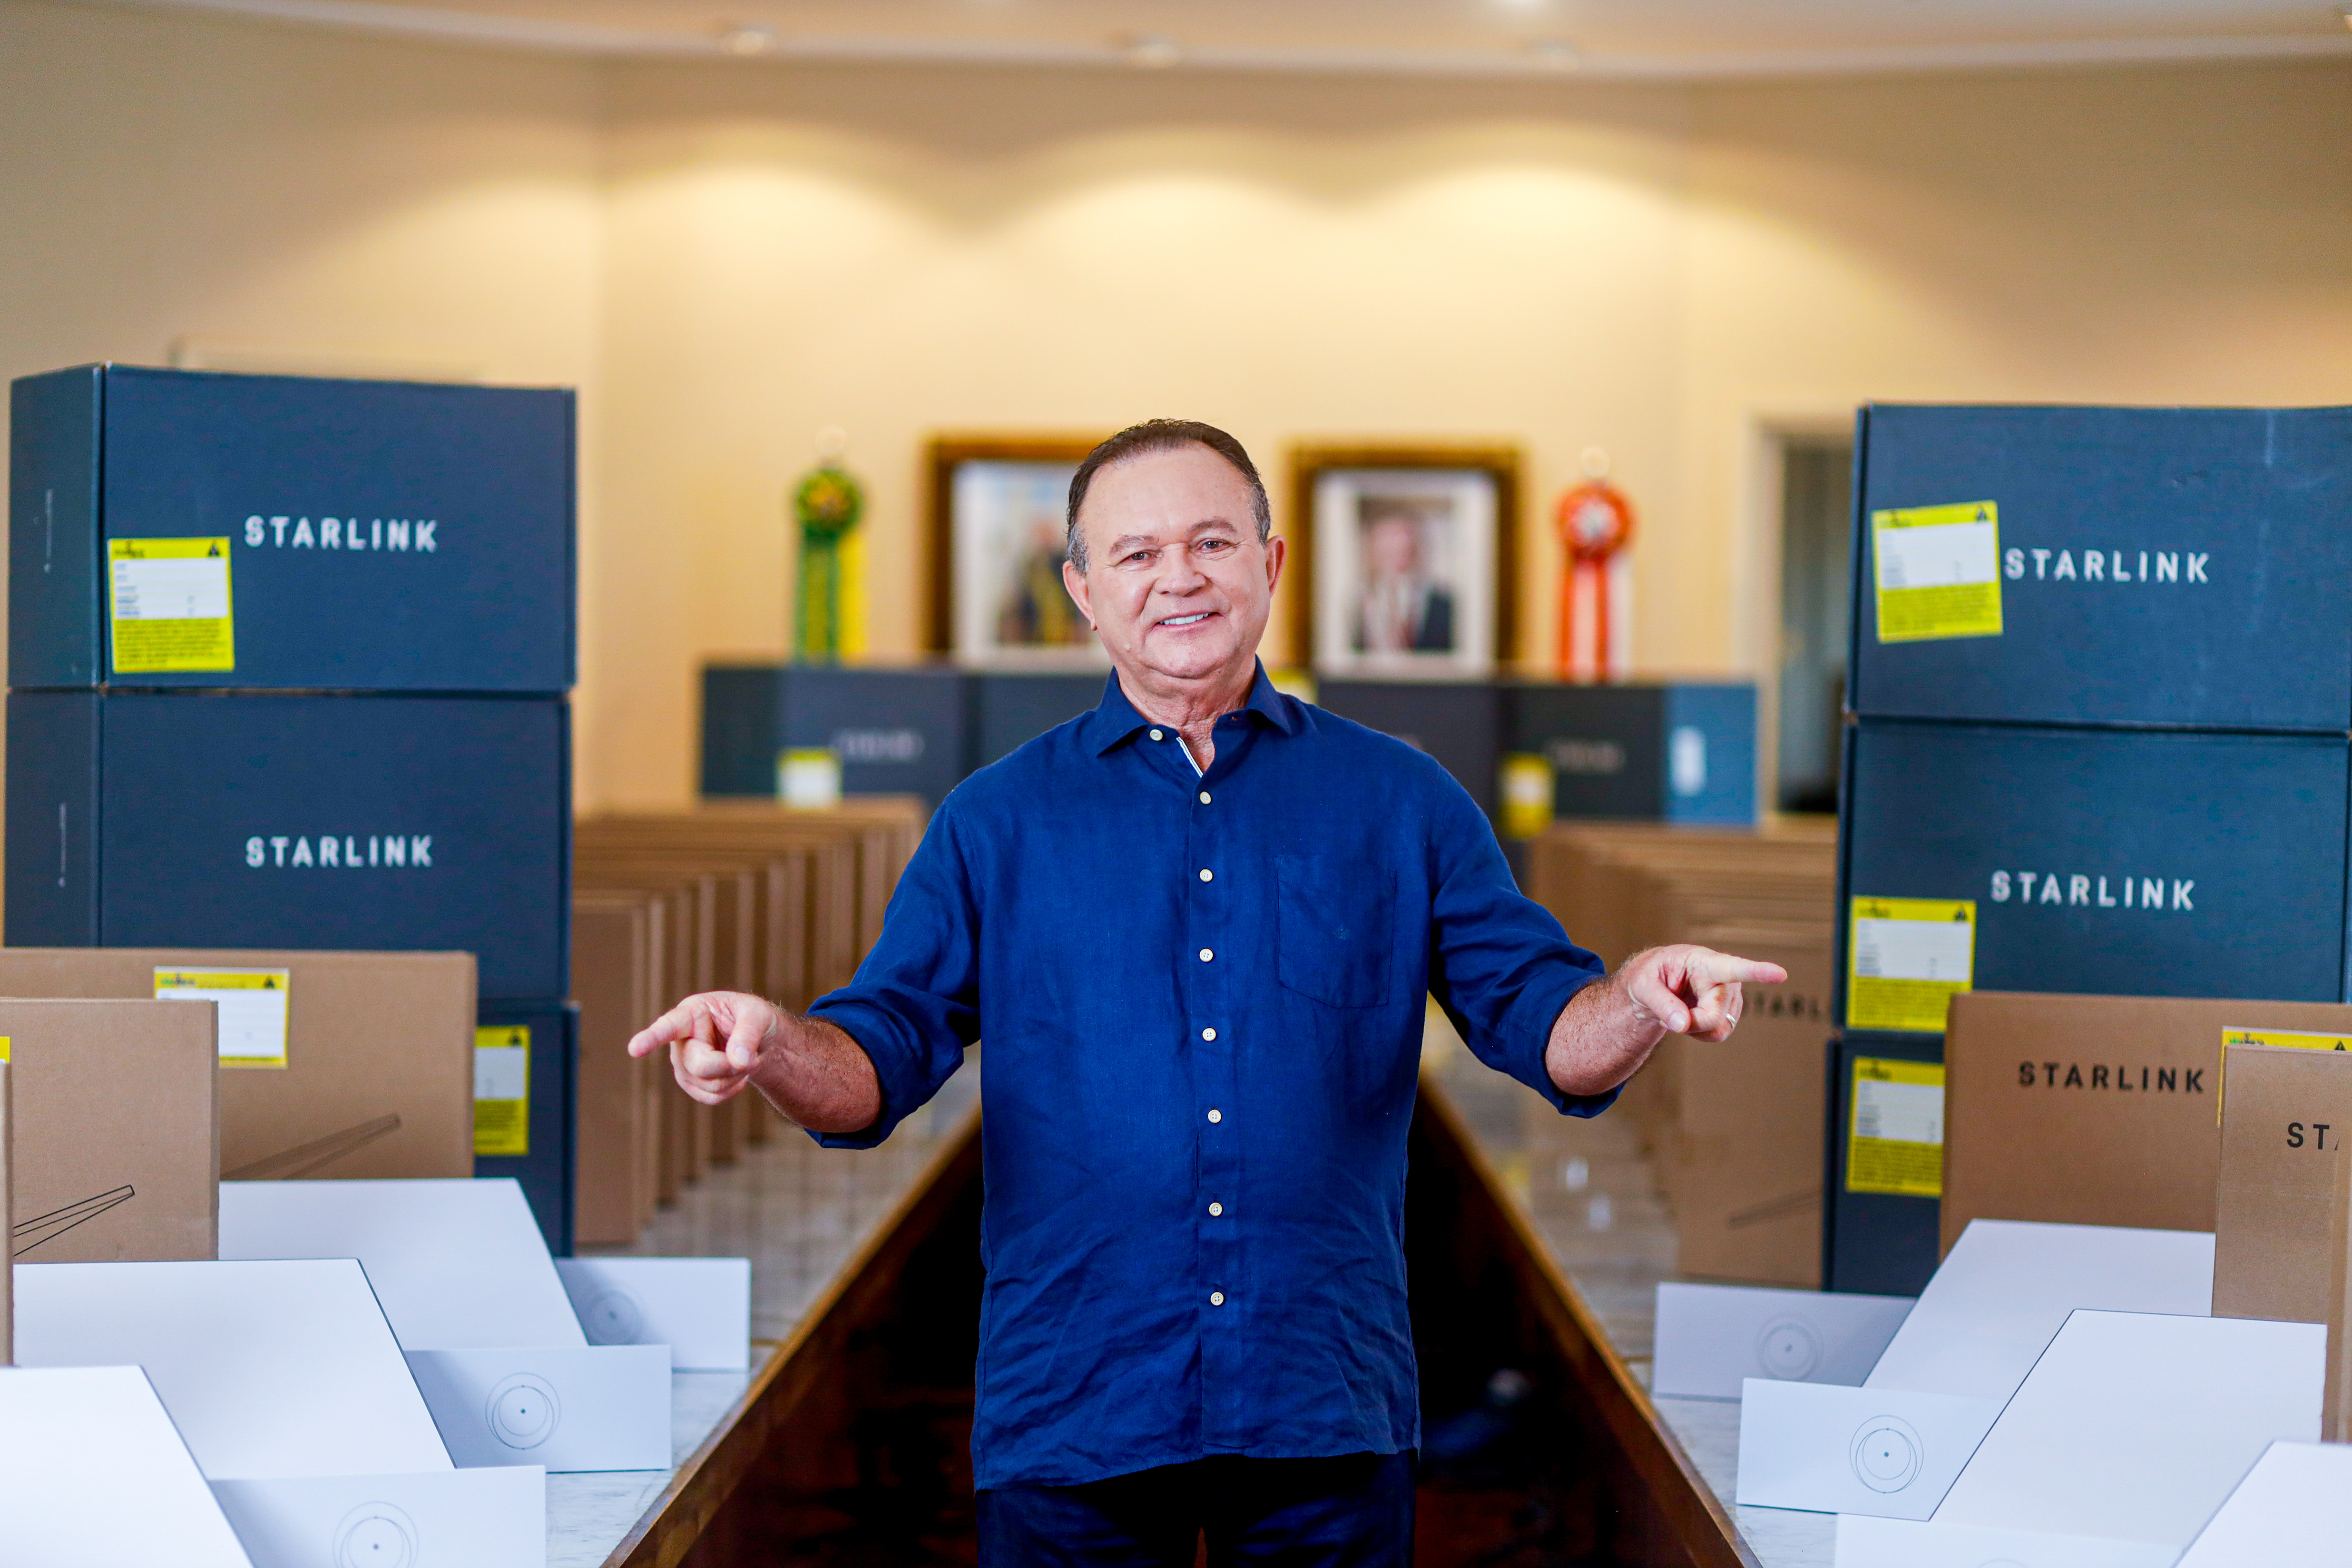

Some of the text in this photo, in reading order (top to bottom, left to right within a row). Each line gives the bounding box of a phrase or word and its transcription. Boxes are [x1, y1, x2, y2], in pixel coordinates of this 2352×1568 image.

[245, 515, 436, 552] STARLINK
[2005, 547, 2209, 583] STARLINK
[246, 835, 432, 868] STARLINK
[1992, 870, 2195, 911] STARLINK
[2017, 1061, 2203, 1093] STARLINK
[2286, 1122, 2340, 1151] ST
